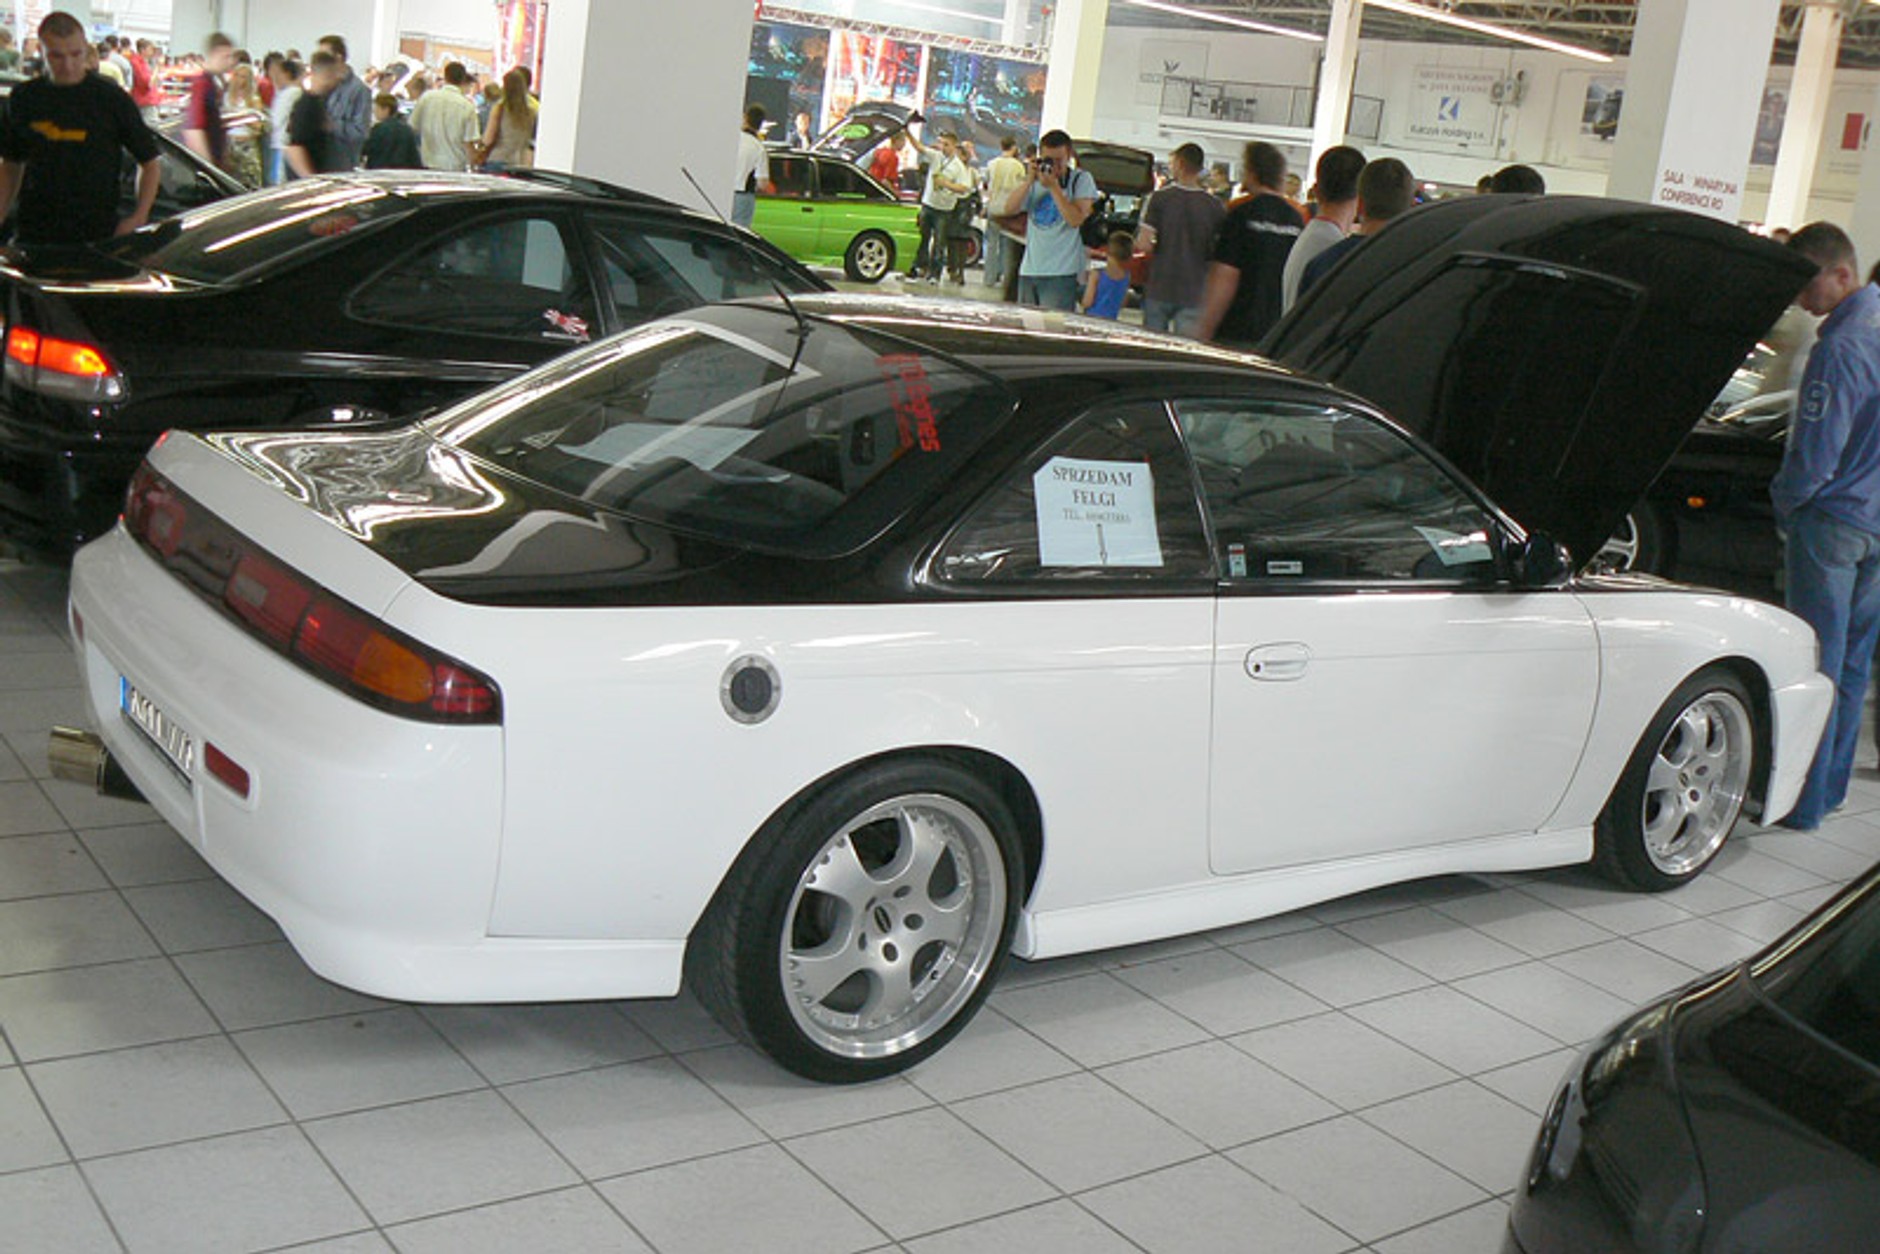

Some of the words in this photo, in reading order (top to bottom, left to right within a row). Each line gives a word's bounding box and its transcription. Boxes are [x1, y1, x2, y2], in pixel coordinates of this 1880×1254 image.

[1663, 168, 1684, 184] SALA
[1052, 465, 1132, 487] SPRZEDAM
[1072, 488, 1116, 507] FELGI
